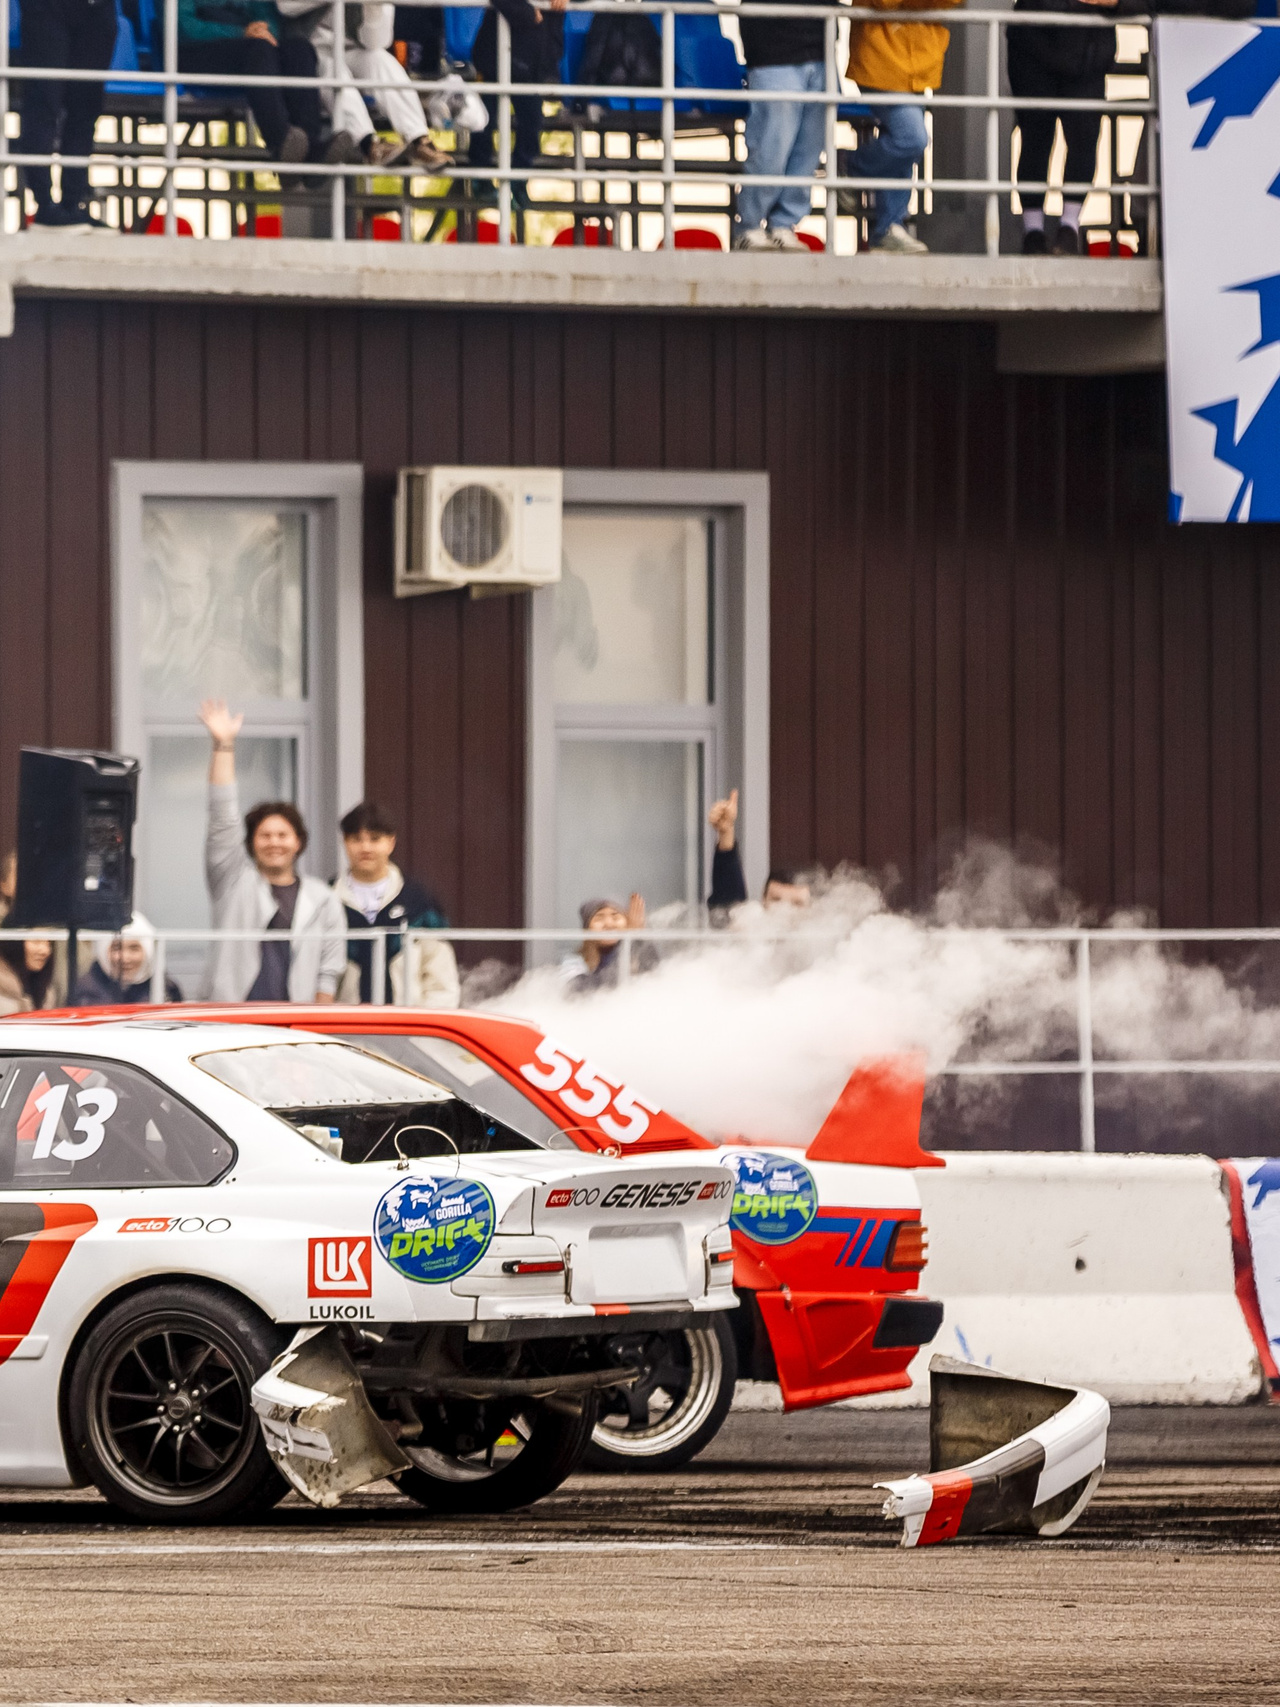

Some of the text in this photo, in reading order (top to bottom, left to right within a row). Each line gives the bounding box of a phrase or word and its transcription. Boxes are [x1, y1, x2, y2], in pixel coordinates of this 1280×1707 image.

[520, 1033, 662, 1144] 555
[31, 1083, 118, 1162] 13
[435, 1202, 472, 1221] GORILLA
[600, 1180, 702, 1209] GENESIS
[389, 1217, 486, 1259] DRIFT
[309, 1305, 376, 1320] LUKOIL
